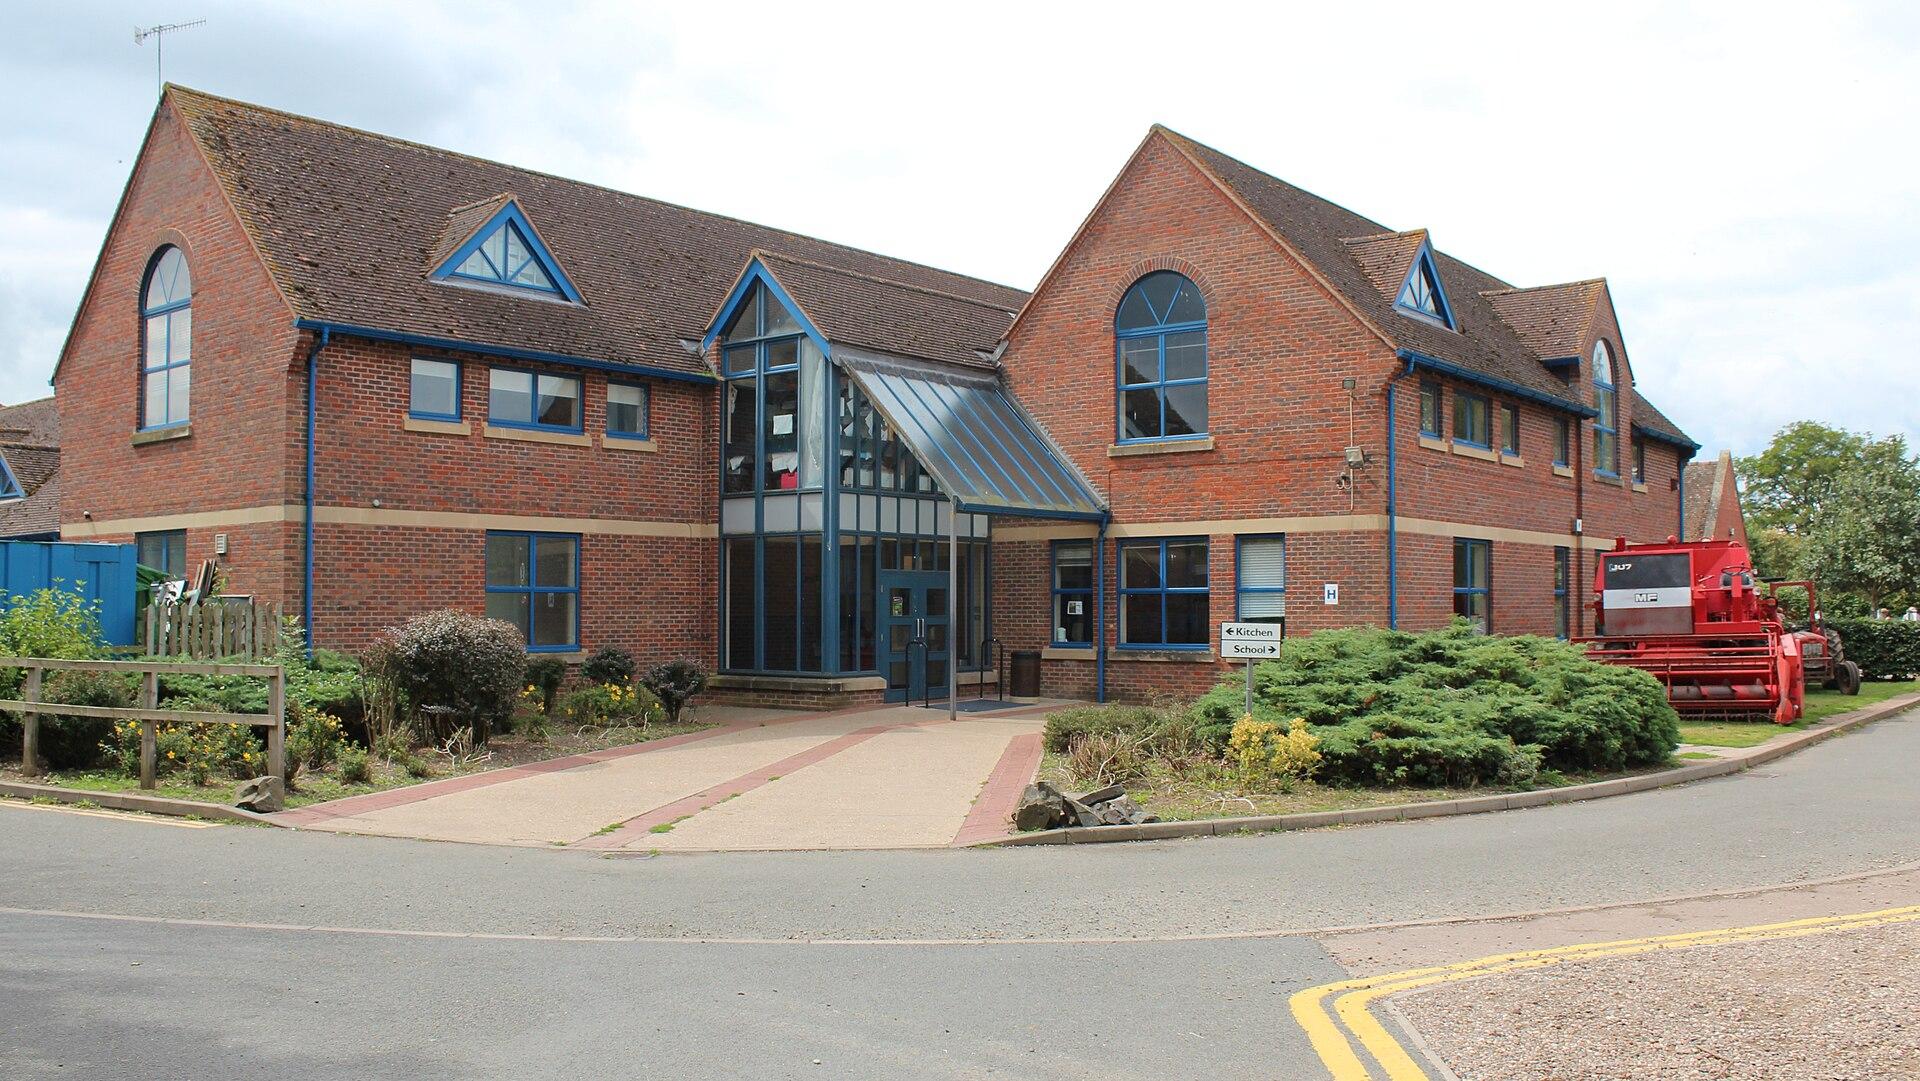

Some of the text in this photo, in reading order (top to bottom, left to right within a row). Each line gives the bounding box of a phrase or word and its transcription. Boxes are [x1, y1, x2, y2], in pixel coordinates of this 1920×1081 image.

[1327, 589, 1336, 600] H
[1635, 593, 1658, 602] MF
[1236, 627, 1273, 637] Kitchen
[1233, 644, 1266, 654] School
